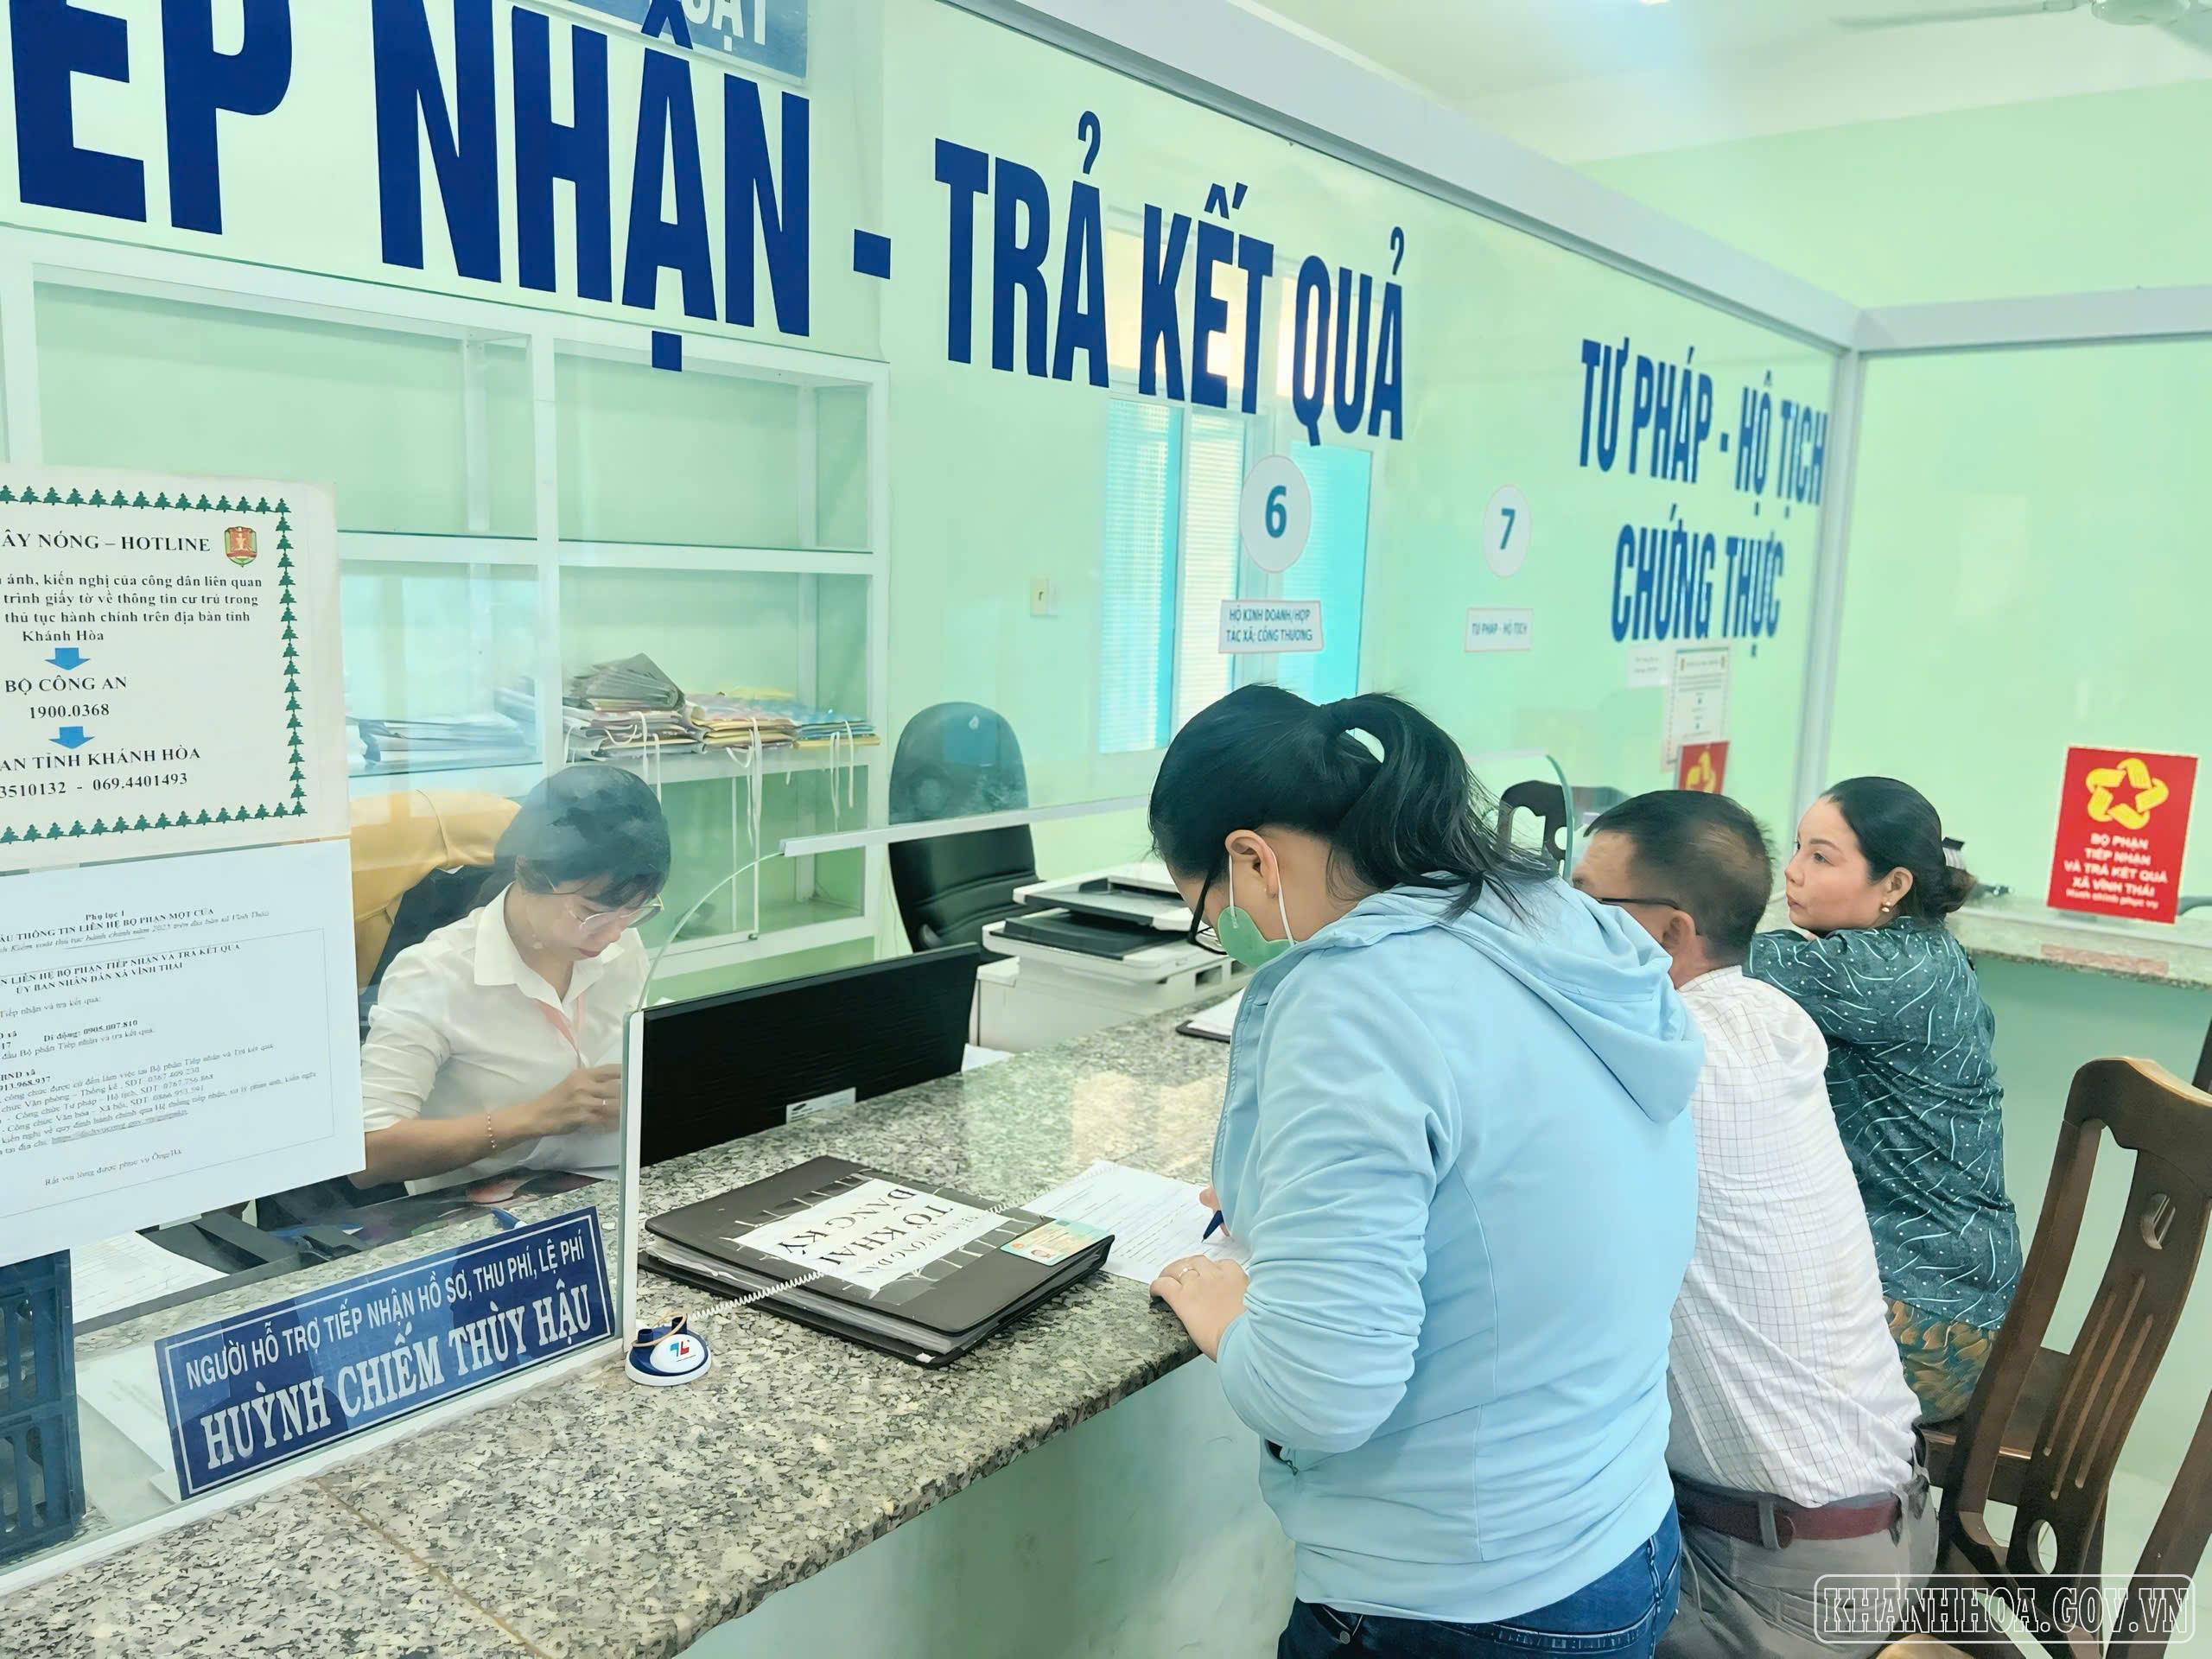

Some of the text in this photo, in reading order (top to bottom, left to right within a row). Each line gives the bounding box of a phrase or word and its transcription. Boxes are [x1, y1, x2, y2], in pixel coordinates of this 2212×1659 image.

[372, 0, 810, 372] NHẬN
[853, 229, 891, 279] -
[935, 111, 1109, 388] TRẢ
[1138, 182, 1274, 414] KẾT
[1291, 226, 1404, 446] QUẢ
[1580, 336, 1828, 520] TƯ PHÁP - HỘ TỊCH
[1265, 485, 1287, 538] 6
[1500, 508, 1516, 550] 7
[39, 531, 99, 549] NÓNG
[122, 537, 211, 552] HOTLINE
[43, 571, 74, 585] kiến
[79, 575, 110, 588] nghị
[142, 574, 172, 588] công
[176, 575, 200, 587] dân
[205, 575, 226, 588] liên
[231, 577, 262, 589] quan
[1611, 503, 1785, 658] CHỨNG THỰC
[45, 590, 74, 607] giấy
[79, 594, 93, 604] tờ
[118, 593, 156, 607] thông
[160, 594, 177, 605] tin
[181, 594, 197, 605] cư
[225, 594, 258, 607] trong
[34, 612, 55, 626] tục
[61, 611, 96, 623] hành
[100, 611, 138, 623] chính
[143, 611, 169, 622] trên
[174, 611, 194, 625] địa
[199, 611, 221, 622] bàn
[22, 630, 104, 642] Khánh Hòa
[5, 675, 127, 695] BỘ CÔNG AN
[29, 703, 110, 719] 1900.0368
[88, 747, 156, 765] KHÁNH
[162, 744, 200, 761] HÒA
[93, 772, 188, 791] 069.4401493
[825, 1188, 916, 1230] ĐĂNG
[903, 1205, 953, 1229] TỜ
[778, 1230, 829, 1255] KÝ
[819, 1225, 906, 1265] KHAI
[186, 1228, 585, 1390] NGƯỜI HỖ TRỢ TIẾP NHẬN HỒ SƠ, THU PHÍ, LỆ PHÍ
[200, 1278, 591, 1470] HUỲNH CHIẾM THÙY HẬU
